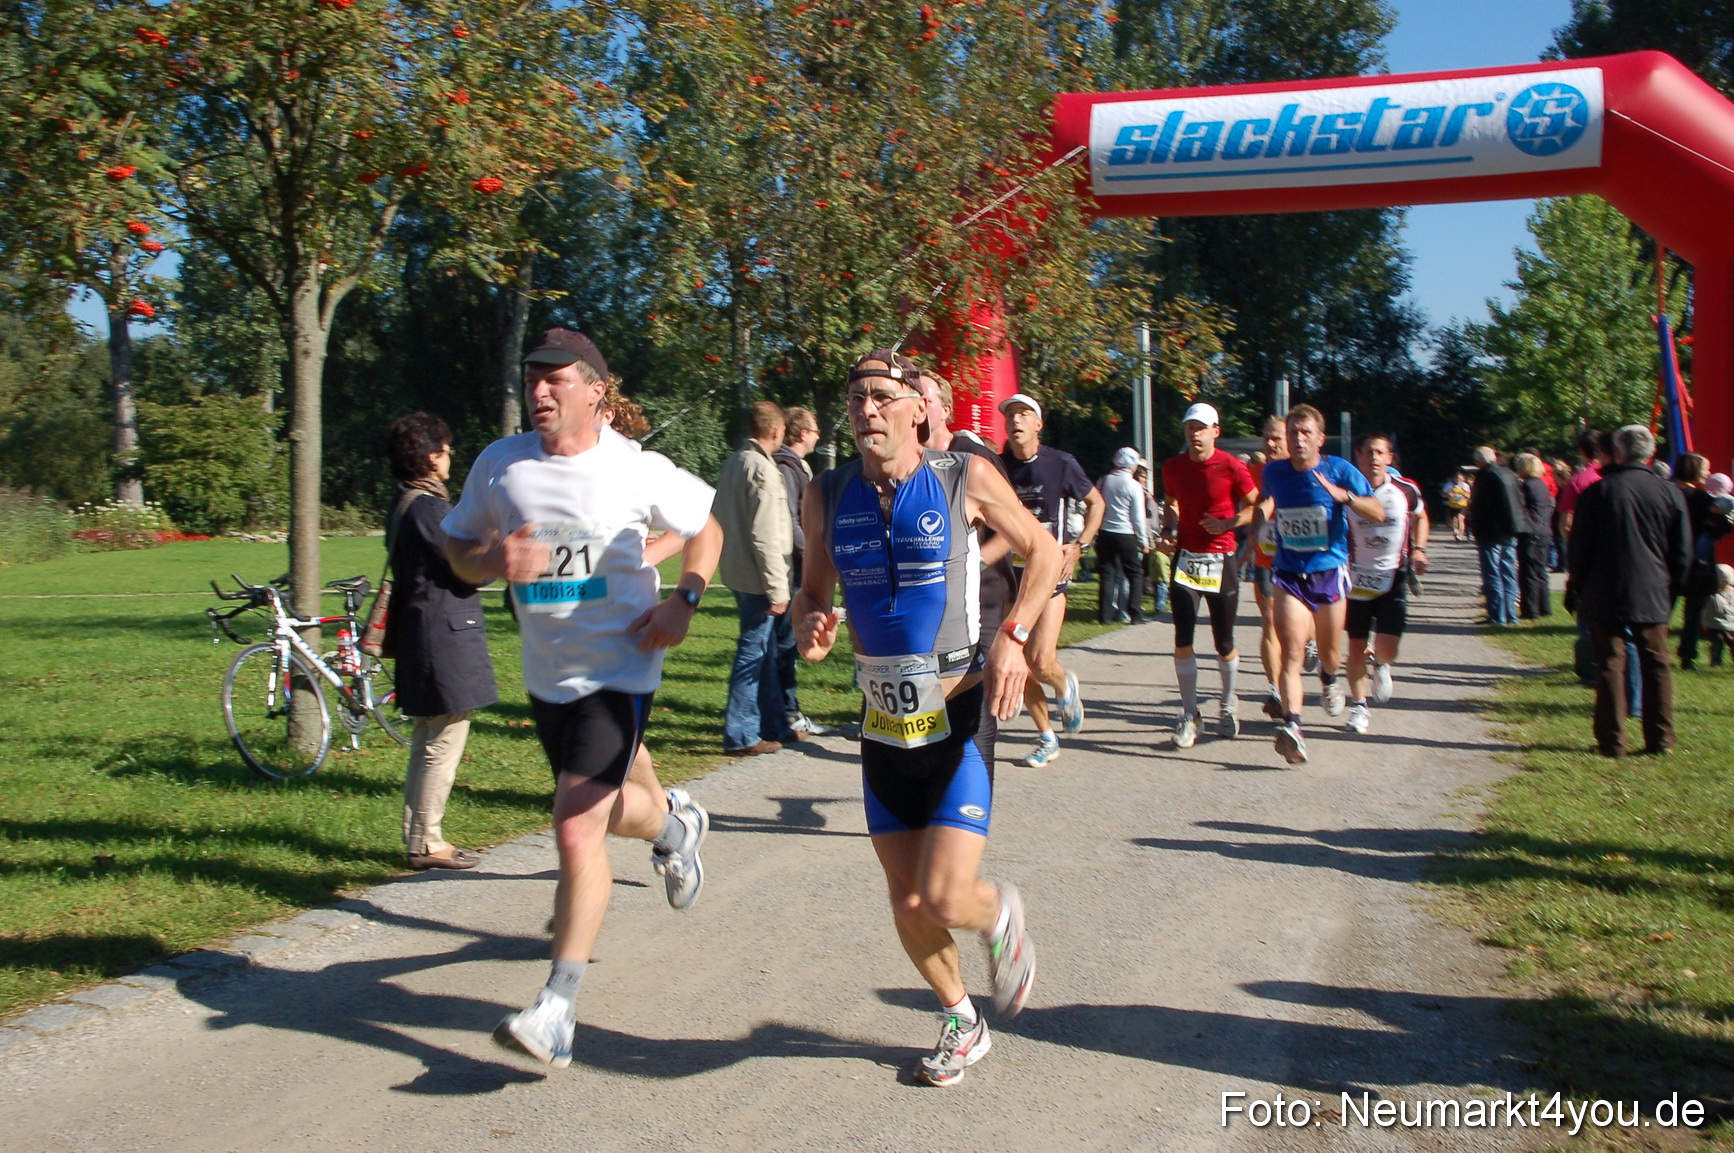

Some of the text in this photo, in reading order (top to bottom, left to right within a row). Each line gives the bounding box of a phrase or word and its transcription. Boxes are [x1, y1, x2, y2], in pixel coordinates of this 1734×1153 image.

[1281, 518, 1320, 536] 2681
[530, 581, 587, 600] Tobias
[869, 679, 919, 715] 669
[871, 711, 937, 736] Johannes
